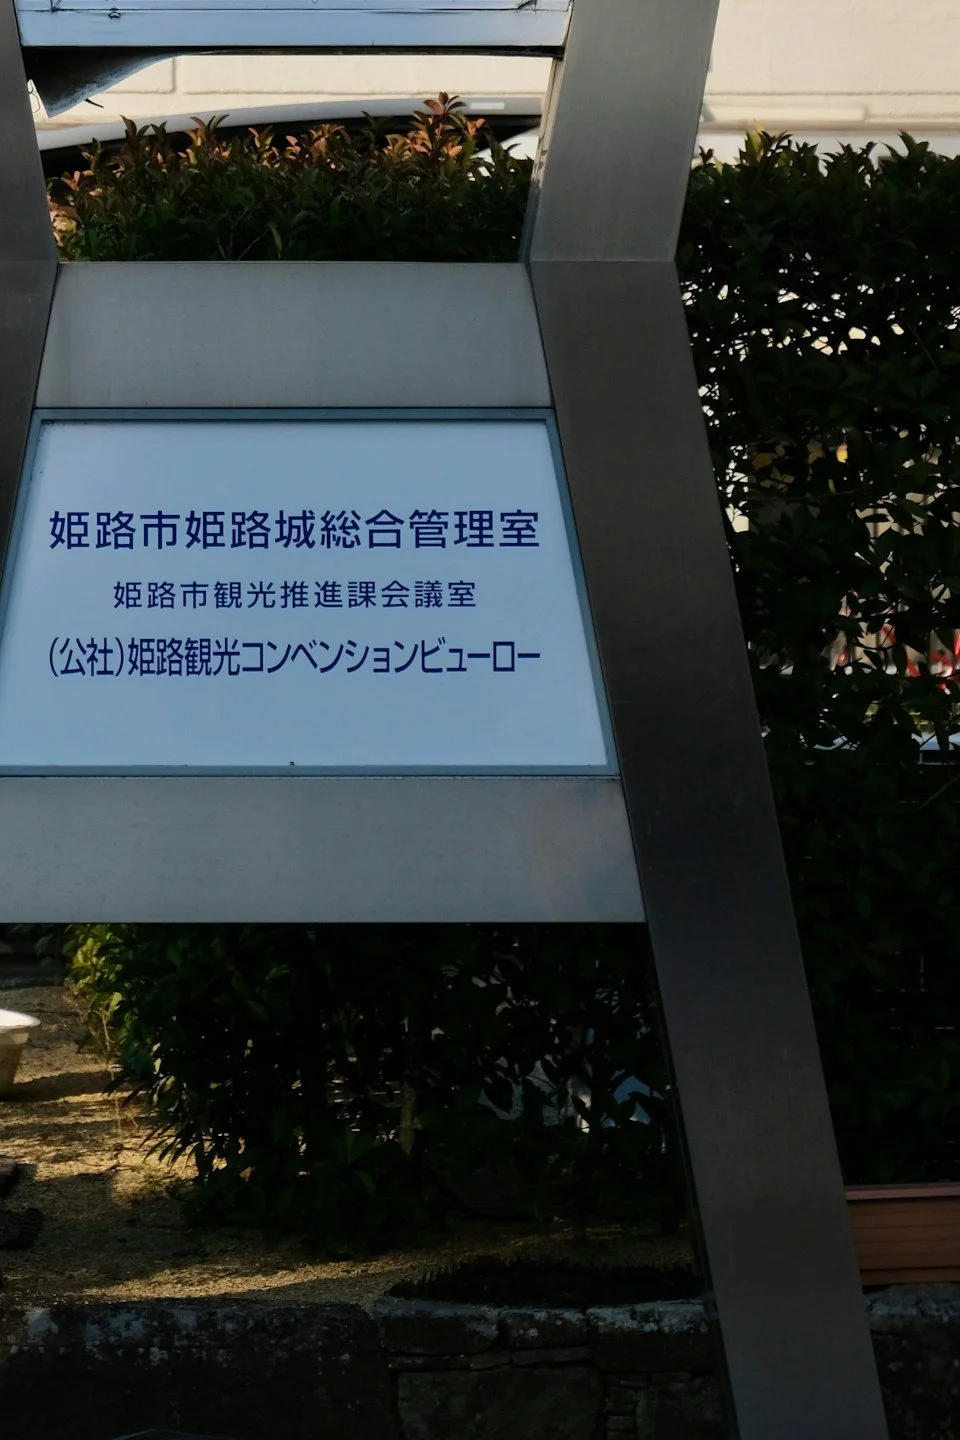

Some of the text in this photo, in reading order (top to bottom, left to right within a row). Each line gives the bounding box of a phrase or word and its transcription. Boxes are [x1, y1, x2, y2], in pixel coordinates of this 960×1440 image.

[49, 509, 539, 550] 姫路市姫路城総合管理室
[113, 580, 476, 609] 姫路市観光推進課会議室
[49, 636, 540, 677] (公社)姫路観光コンベンションビューロー
